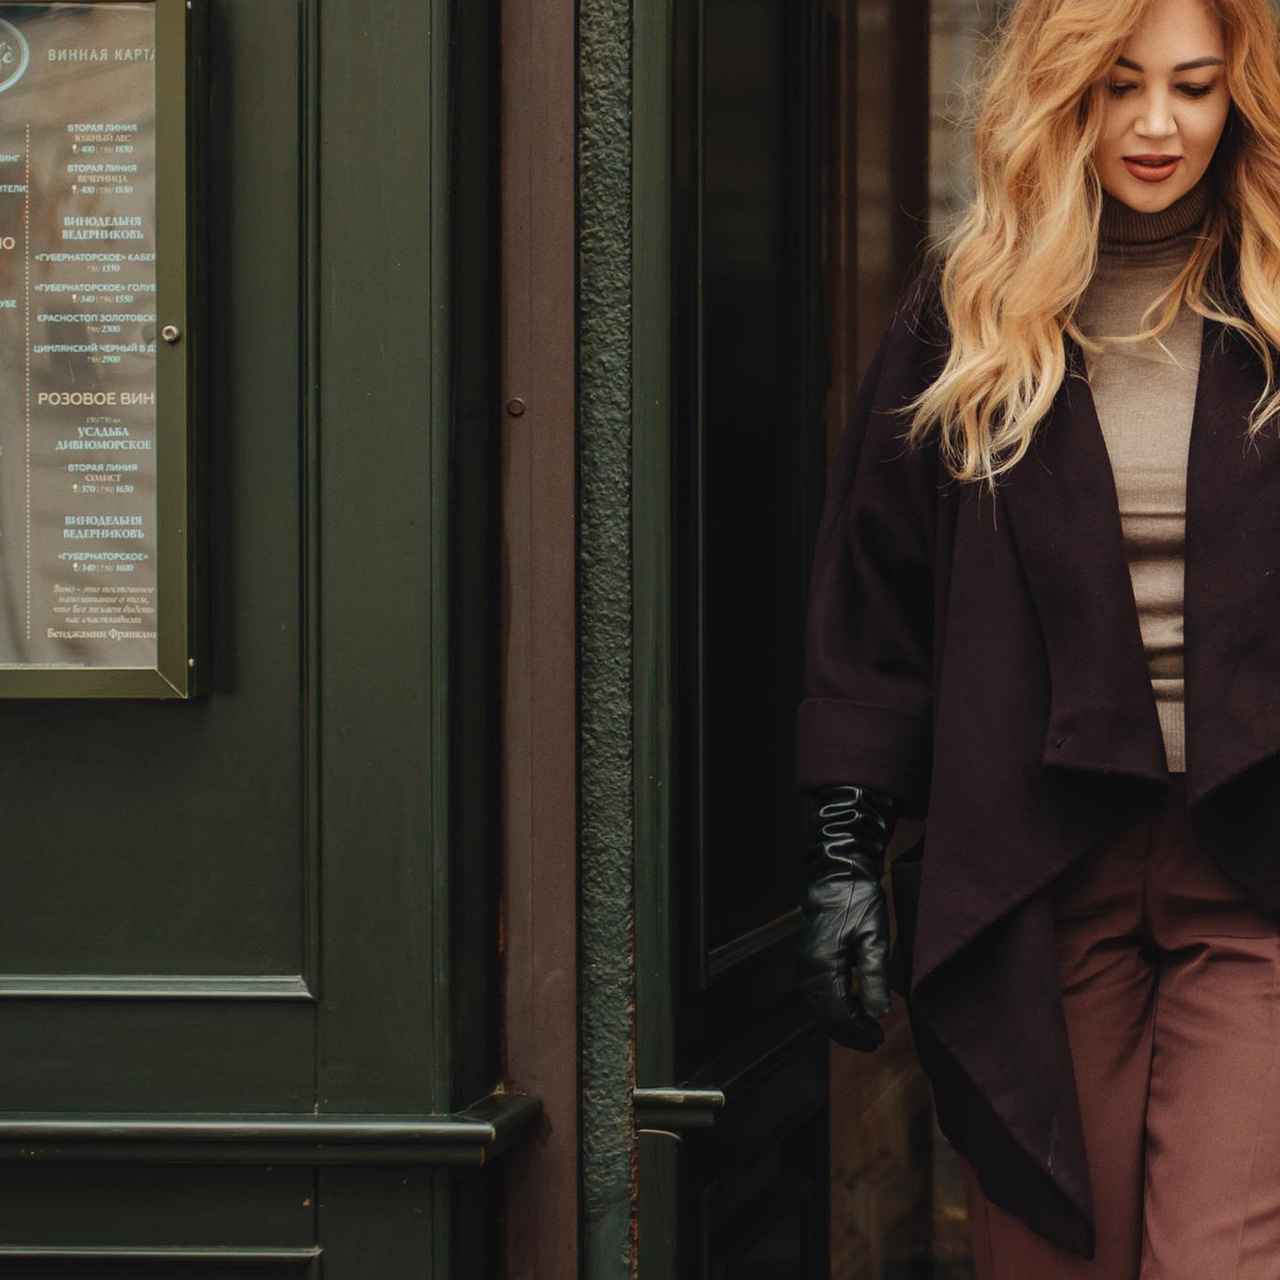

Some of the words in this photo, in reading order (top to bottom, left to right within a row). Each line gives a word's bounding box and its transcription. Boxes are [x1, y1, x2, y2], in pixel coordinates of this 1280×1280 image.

[47, 48, 108, 62] ВИННАЯ
[67, 124, 104, 132] ВТОРАЯ
[105, 124, 138, 132] ЛИНИЯ
[67, 164, 104, 173] ВТОРАЯ
[105, 164, 138, 173] ЛИНИЯ
[63, 216, 142, 227] ВИНОДЕЛЬНЯ
[62, 229, 145, 240] ВЕДЕРНИКОВЪ
[99, 343, 137, 352] ЧЕРНЫЙ
[37, 392, 117, 406] РОЗОВОЕ
[77, 427, 130, 438] УСАДЬБА
[55, 440, 151, 451] ДИВНОМОРСКОЕ
[68, 464, 104, 472] ВТОРАЯ
[105, 464, 138, 472] ЛИНИЯ
[64, 516, 143, 526] ВИНОДЕЛЬНЯ
[63, 529, 145, 539] ВЕДЕРНИКОВЪ
